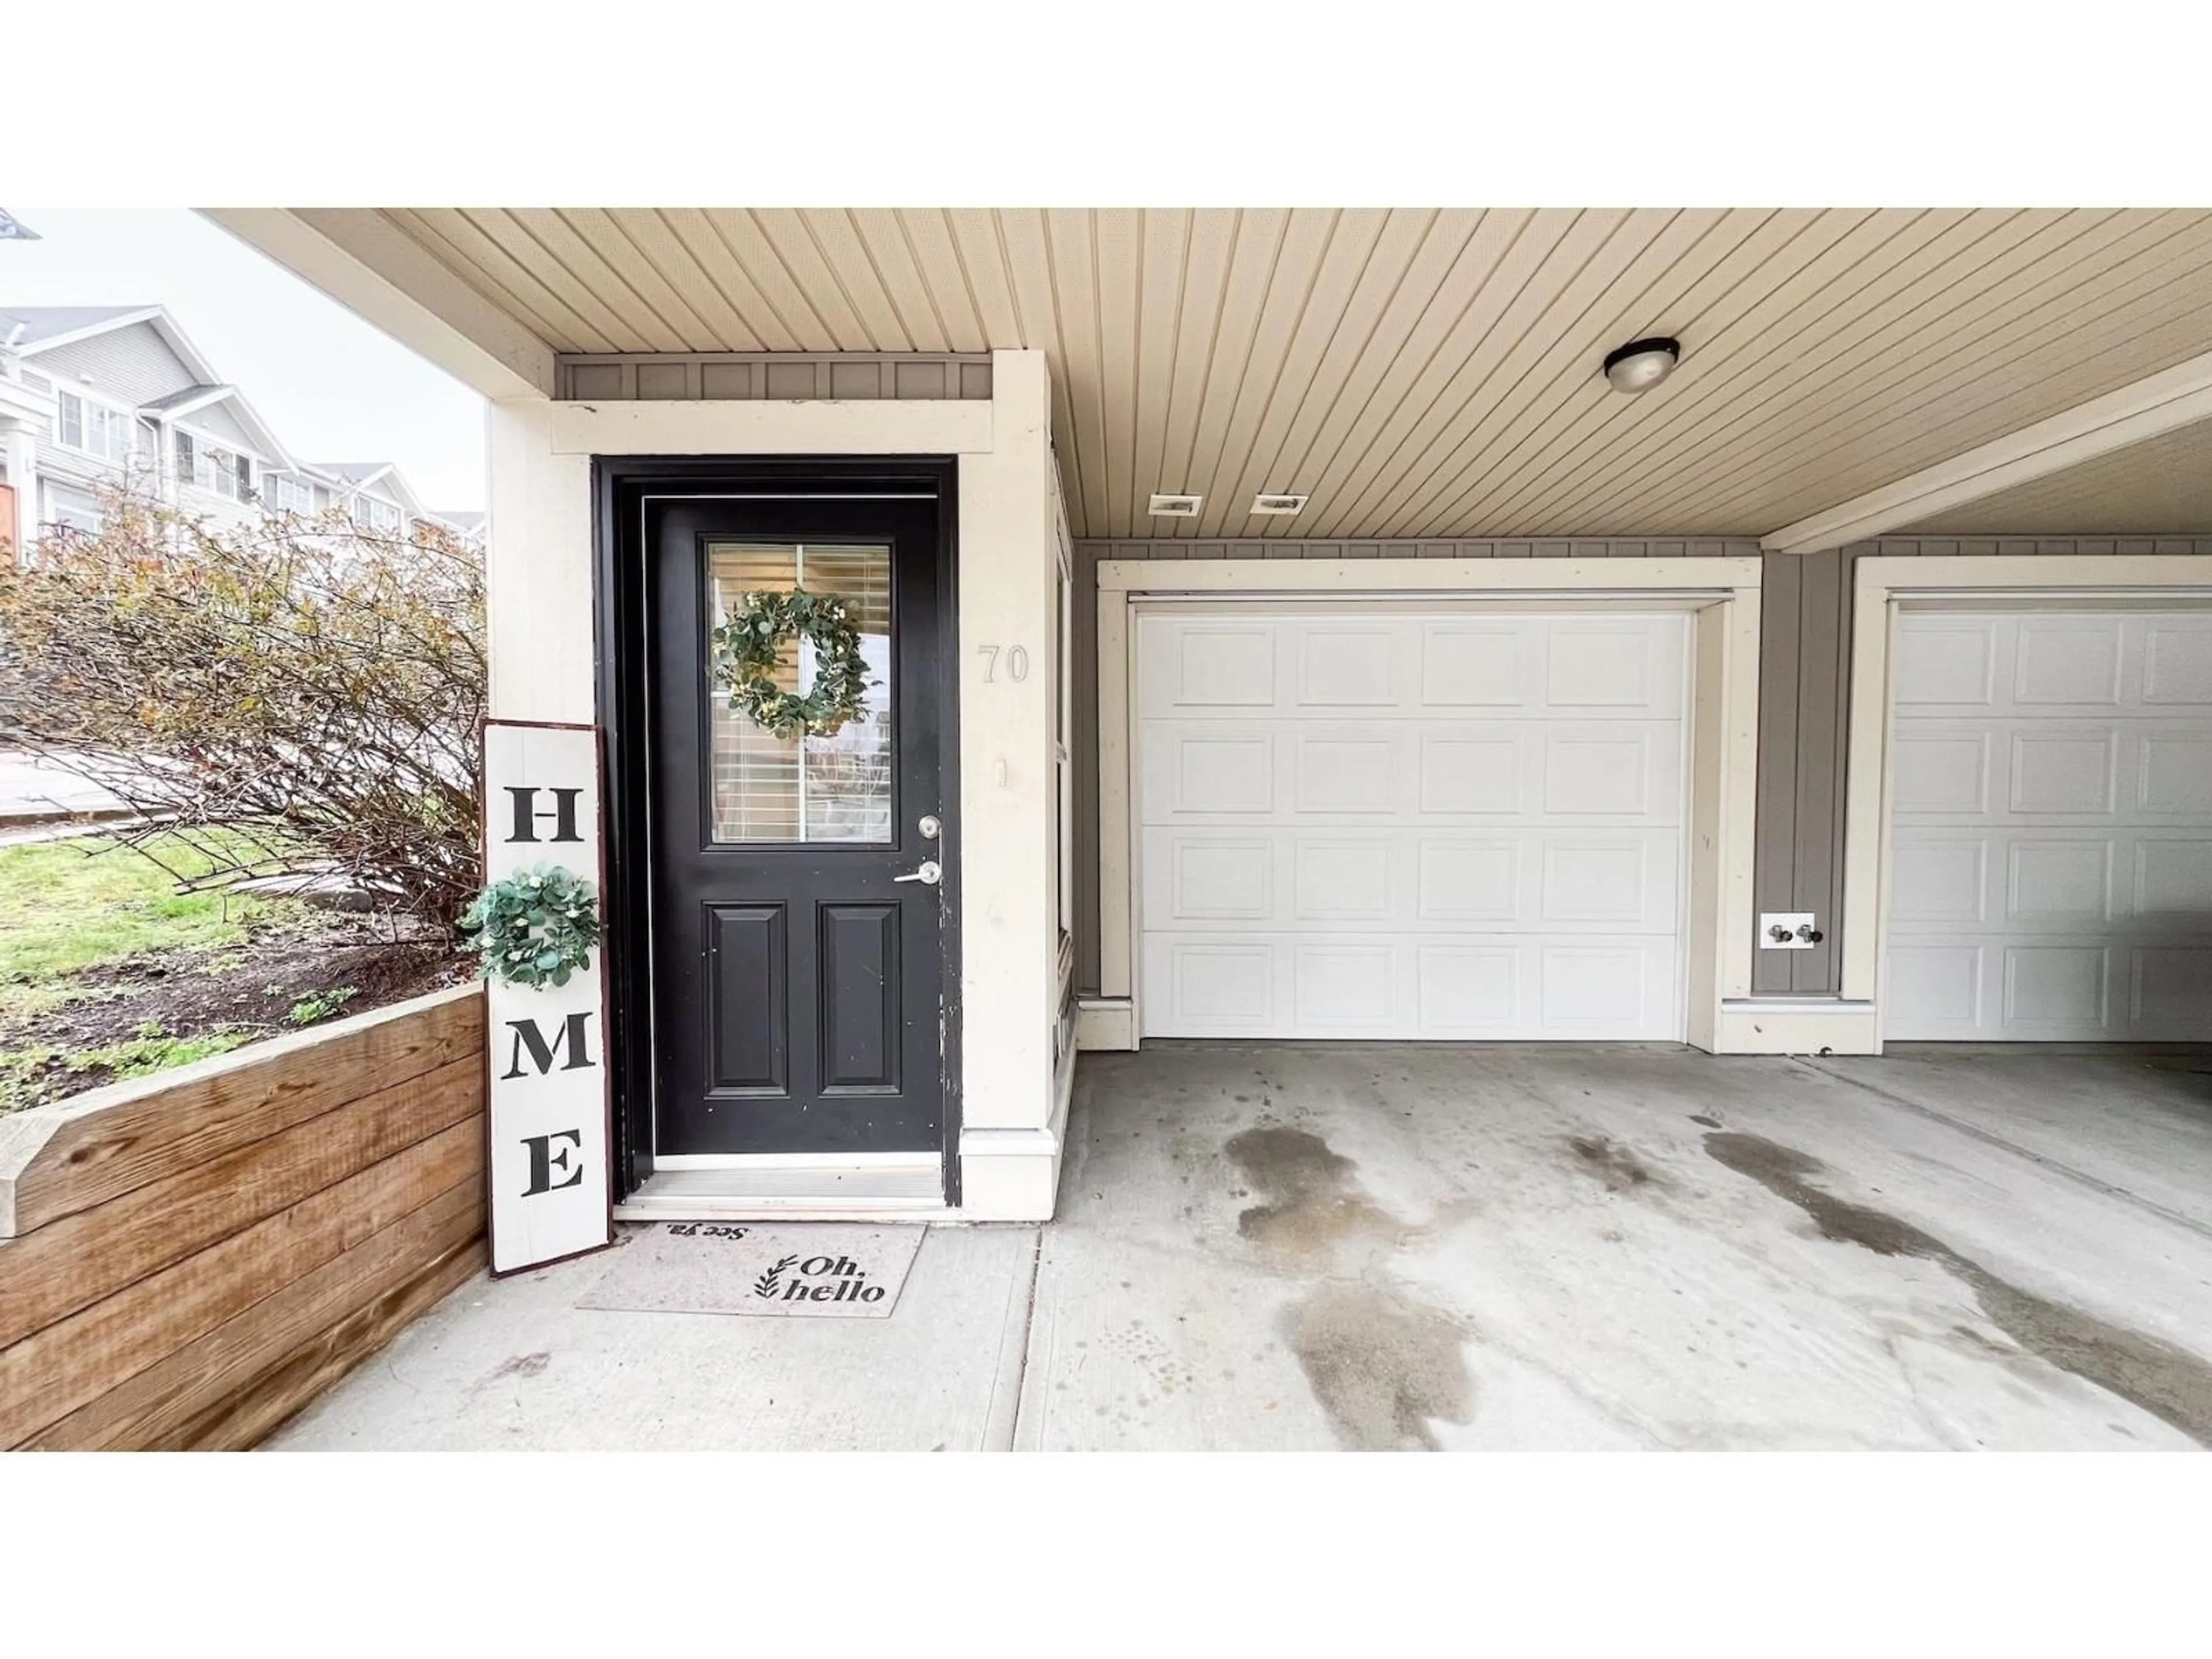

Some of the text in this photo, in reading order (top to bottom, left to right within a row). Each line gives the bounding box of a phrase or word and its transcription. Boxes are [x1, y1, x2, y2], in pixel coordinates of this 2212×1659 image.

[977, 644, 1029, 684] 70
[666, 1222, 749, 1240] See ya.
[800, 1256, 866, 1279] Oh,
[781, 1279, 885, 1302] hello
